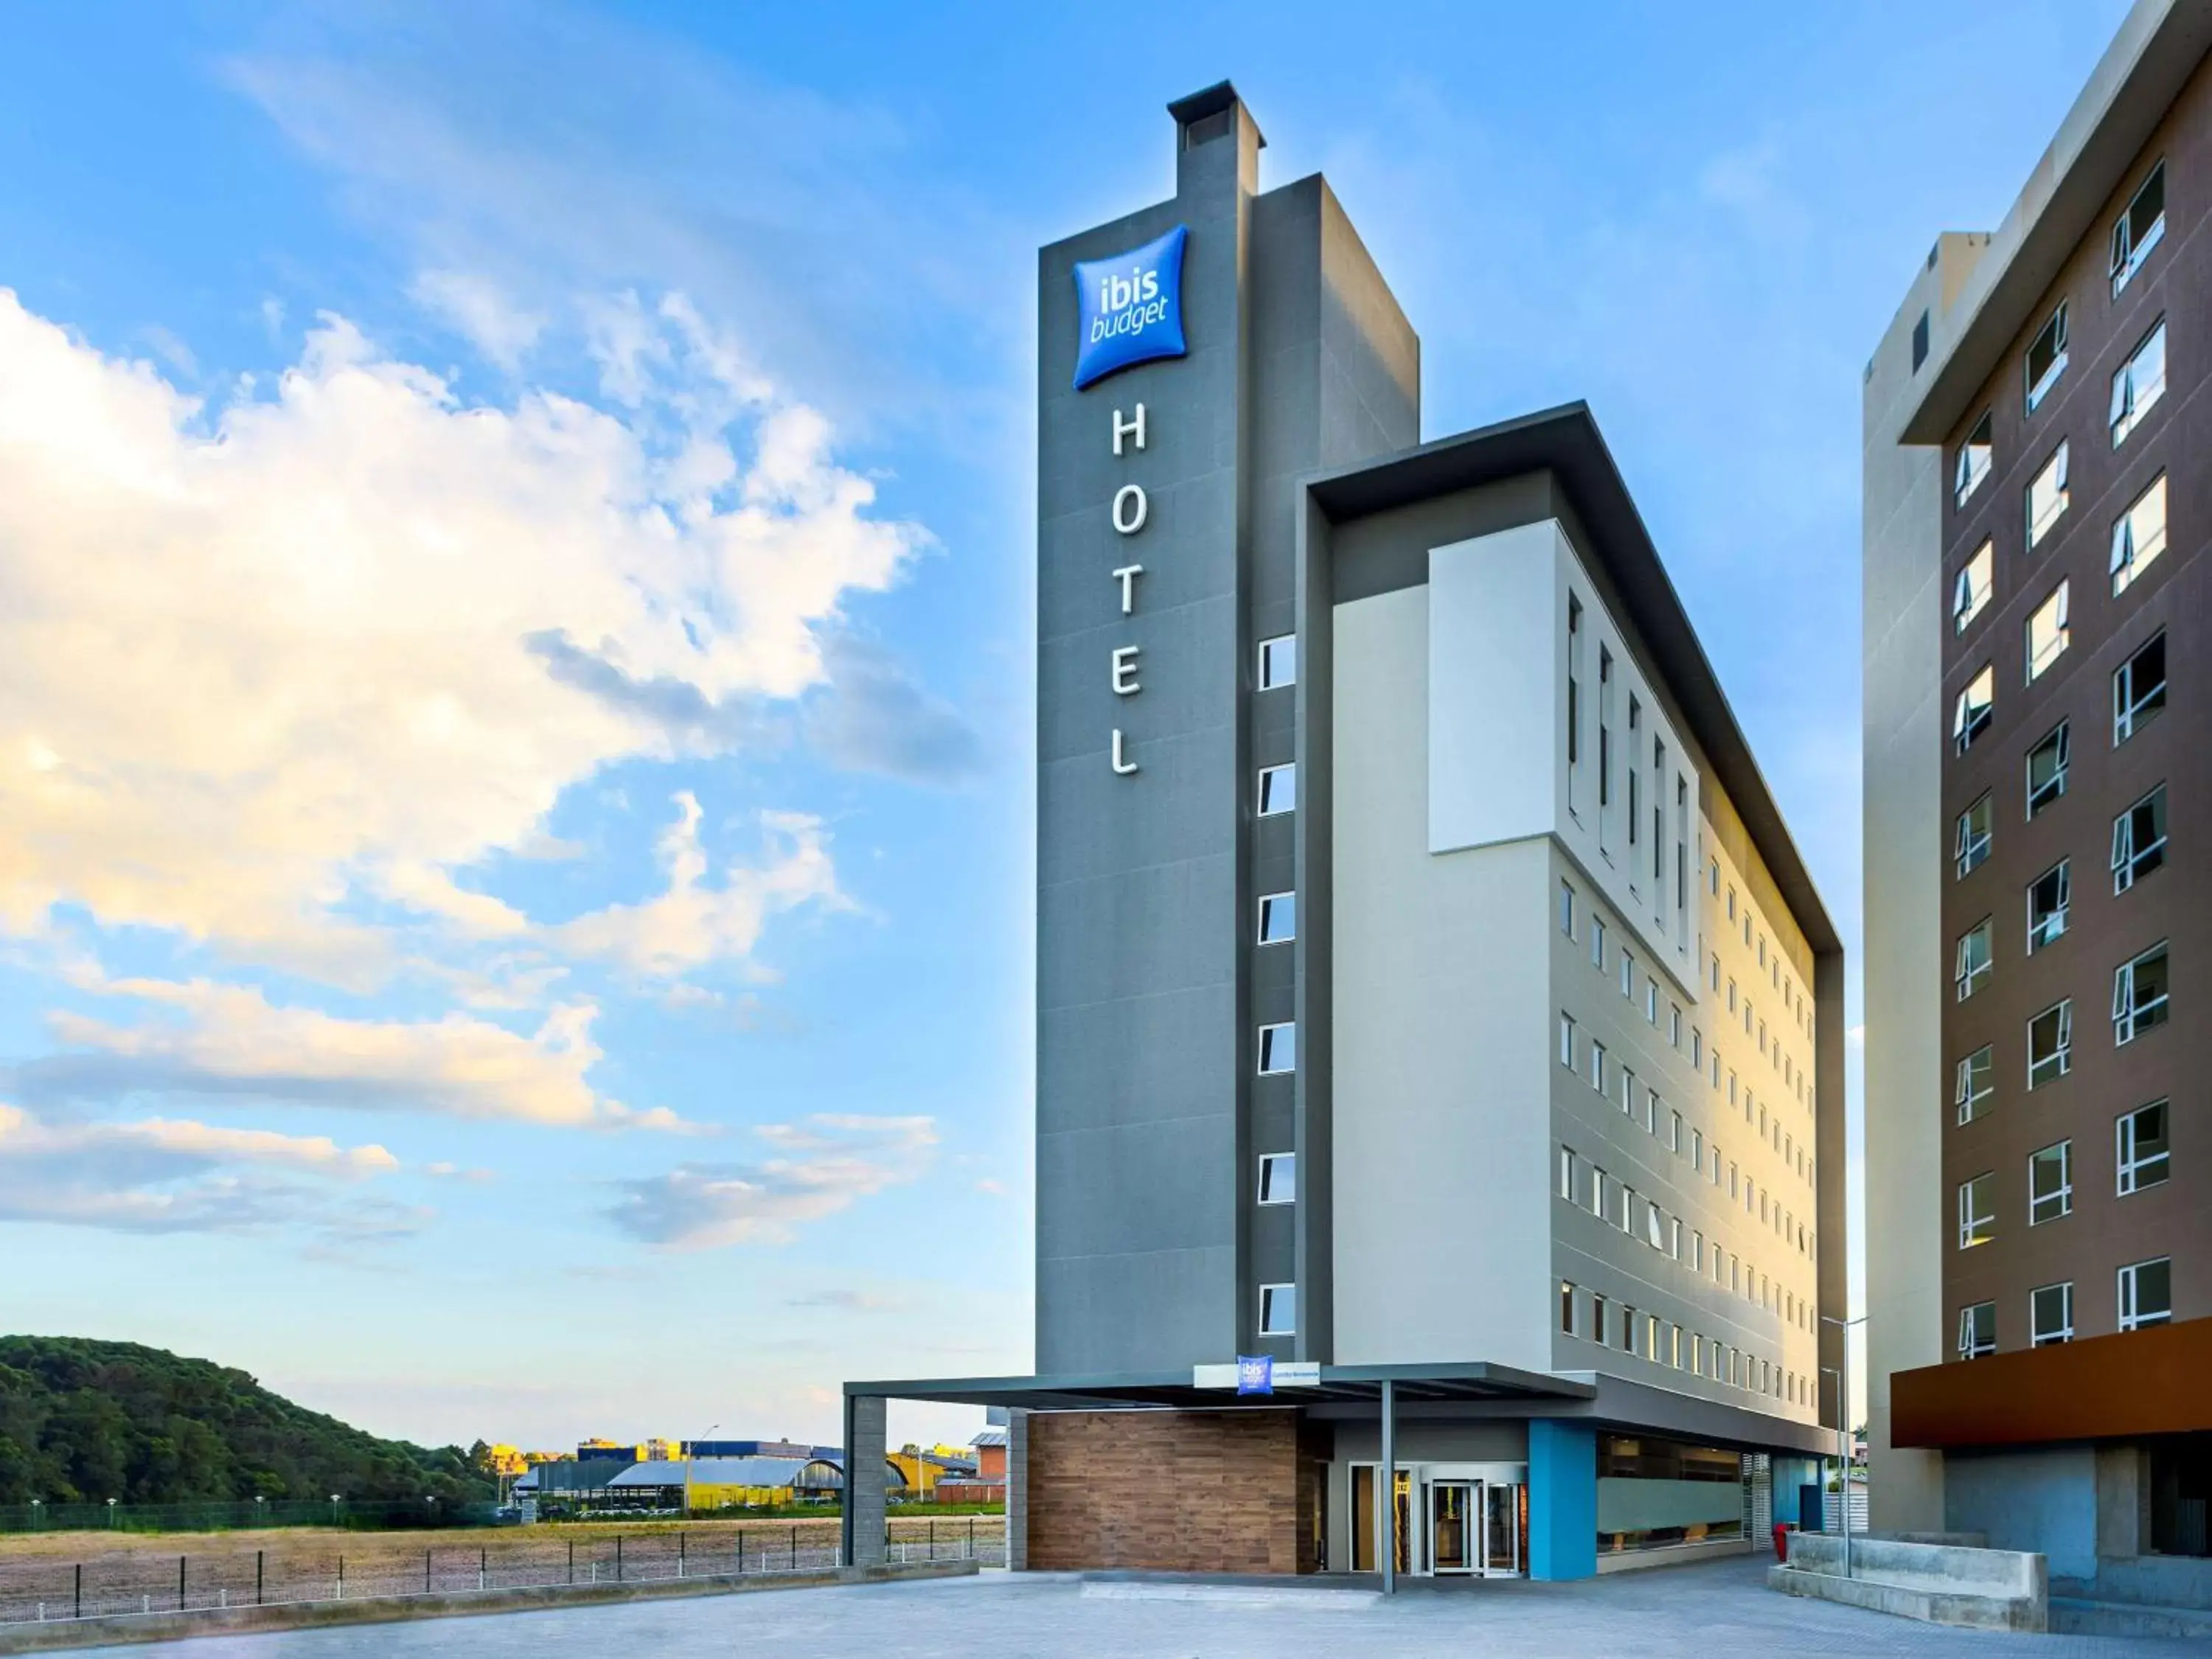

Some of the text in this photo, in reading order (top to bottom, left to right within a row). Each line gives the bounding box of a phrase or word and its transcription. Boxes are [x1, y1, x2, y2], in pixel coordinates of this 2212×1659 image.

[1101, 266, 1158, 314] ibis
[1091, 295, 1168, 343] budget
[1112, 403, 1147, 773] HOTEL
